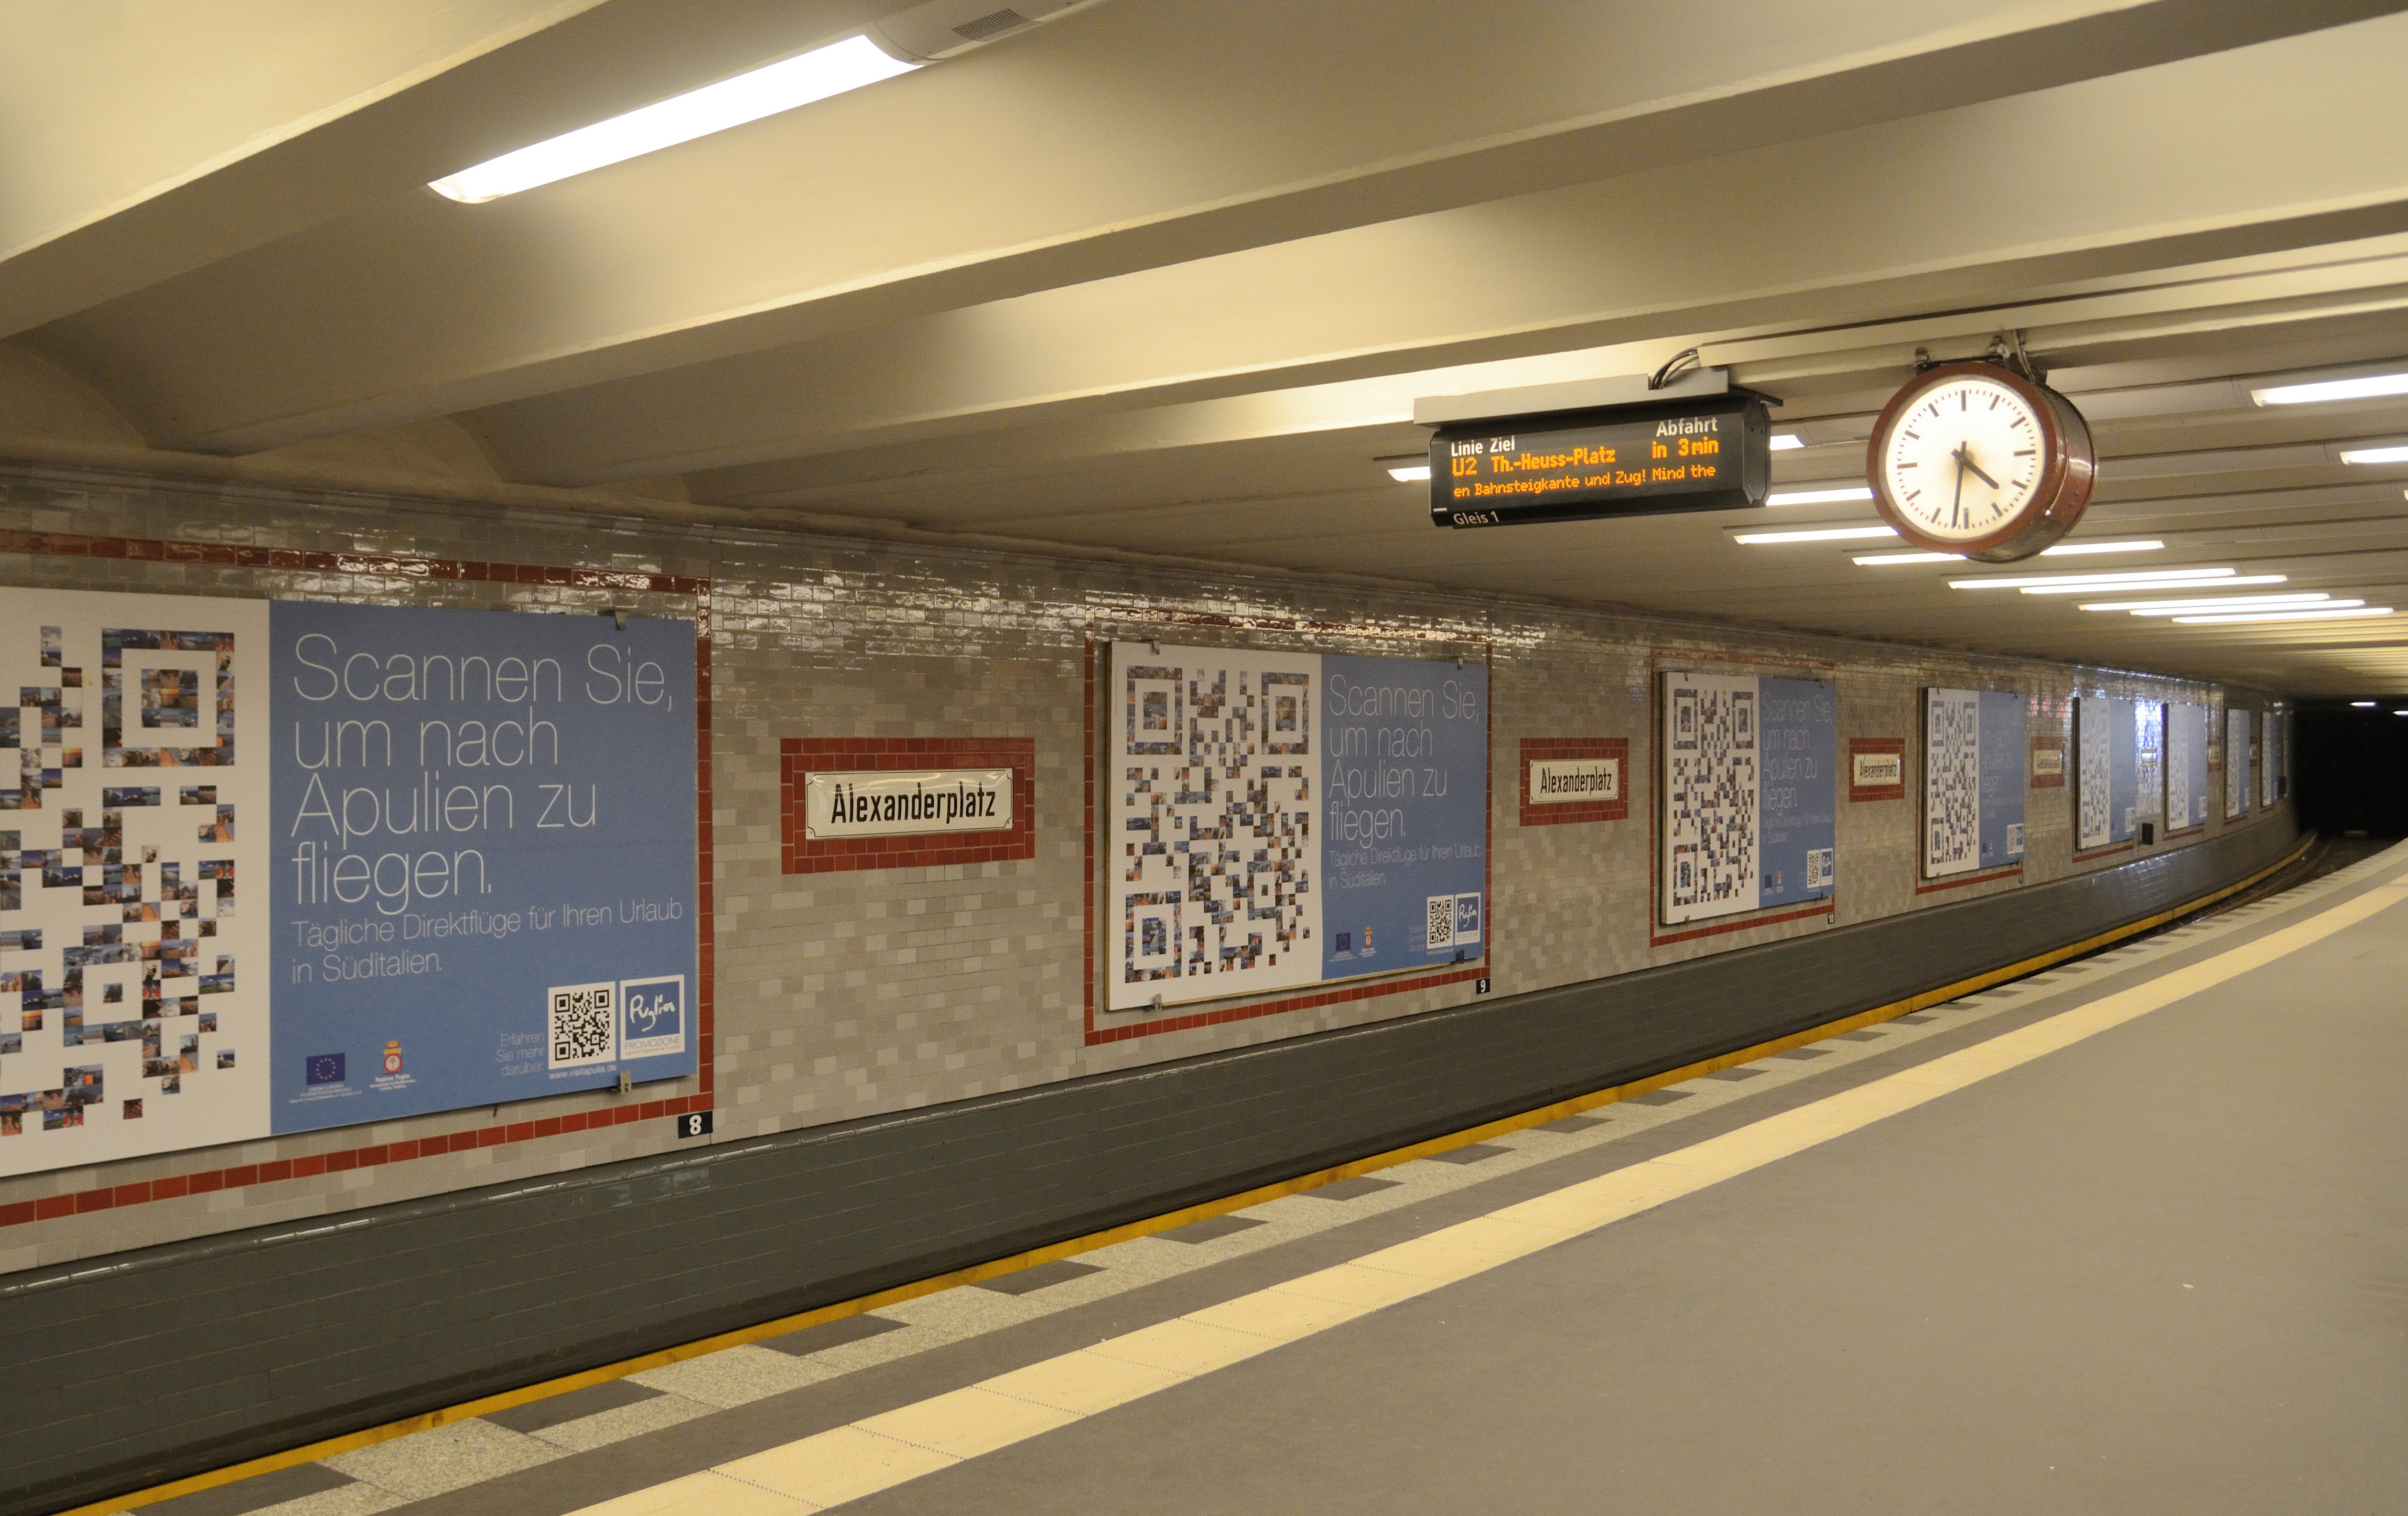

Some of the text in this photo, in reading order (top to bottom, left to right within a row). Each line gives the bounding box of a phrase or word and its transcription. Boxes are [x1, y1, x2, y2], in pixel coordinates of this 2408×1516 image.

[1656, 417, 1718, 437] Abfahrt
[1451, 435, 1515, 457] Linie Ziel
[1452, 457, 1477, 477] U2
[1491, 446, 1616, 473] Th.-Heuss-Platz
[1652, 441, 1667, 459] in
[1453, 464, 1716, 498] en Bahnsteigkante und Zug! Mind the
[1453, 510, 1500, 525] Gleis 1
[293, 633, 672, 712] Scannen Sie,
[1330, 674, 1478, 723] Scannen Sie,
[295, 706, 558, 770] um nach
[1330, 720, 1432, 757] um nach
[1329, 759, 1447, 807] Apulien zu
[1540, 765, 1612, 796] Alexanderplatz
[291, 771, 596, 850] Apulien zu
[830, 780, 996, 824] Alexanderplatz
[1329, 800, 1406, 849] fliegen.
[291, 840, 492, 915] fliegen.
[290, 897, 683, 951] Tägliche Direktflüge für Ihren Urlaub
[293, 949, 442, 984] in Süditalien.
[1480, 979, 1486, 993] 9
[629, 994, 676, 1032] Puglia
[496, 1046, 545, 1062] Sie mehr
[500, 1032, 545, 1047] Erfahren
[624, 1036, 681, 1050] PROMOZIONE
[549, 1064, 617, 1079] www.visitapulia.de
[689, 1114, 702, 1135] 8
